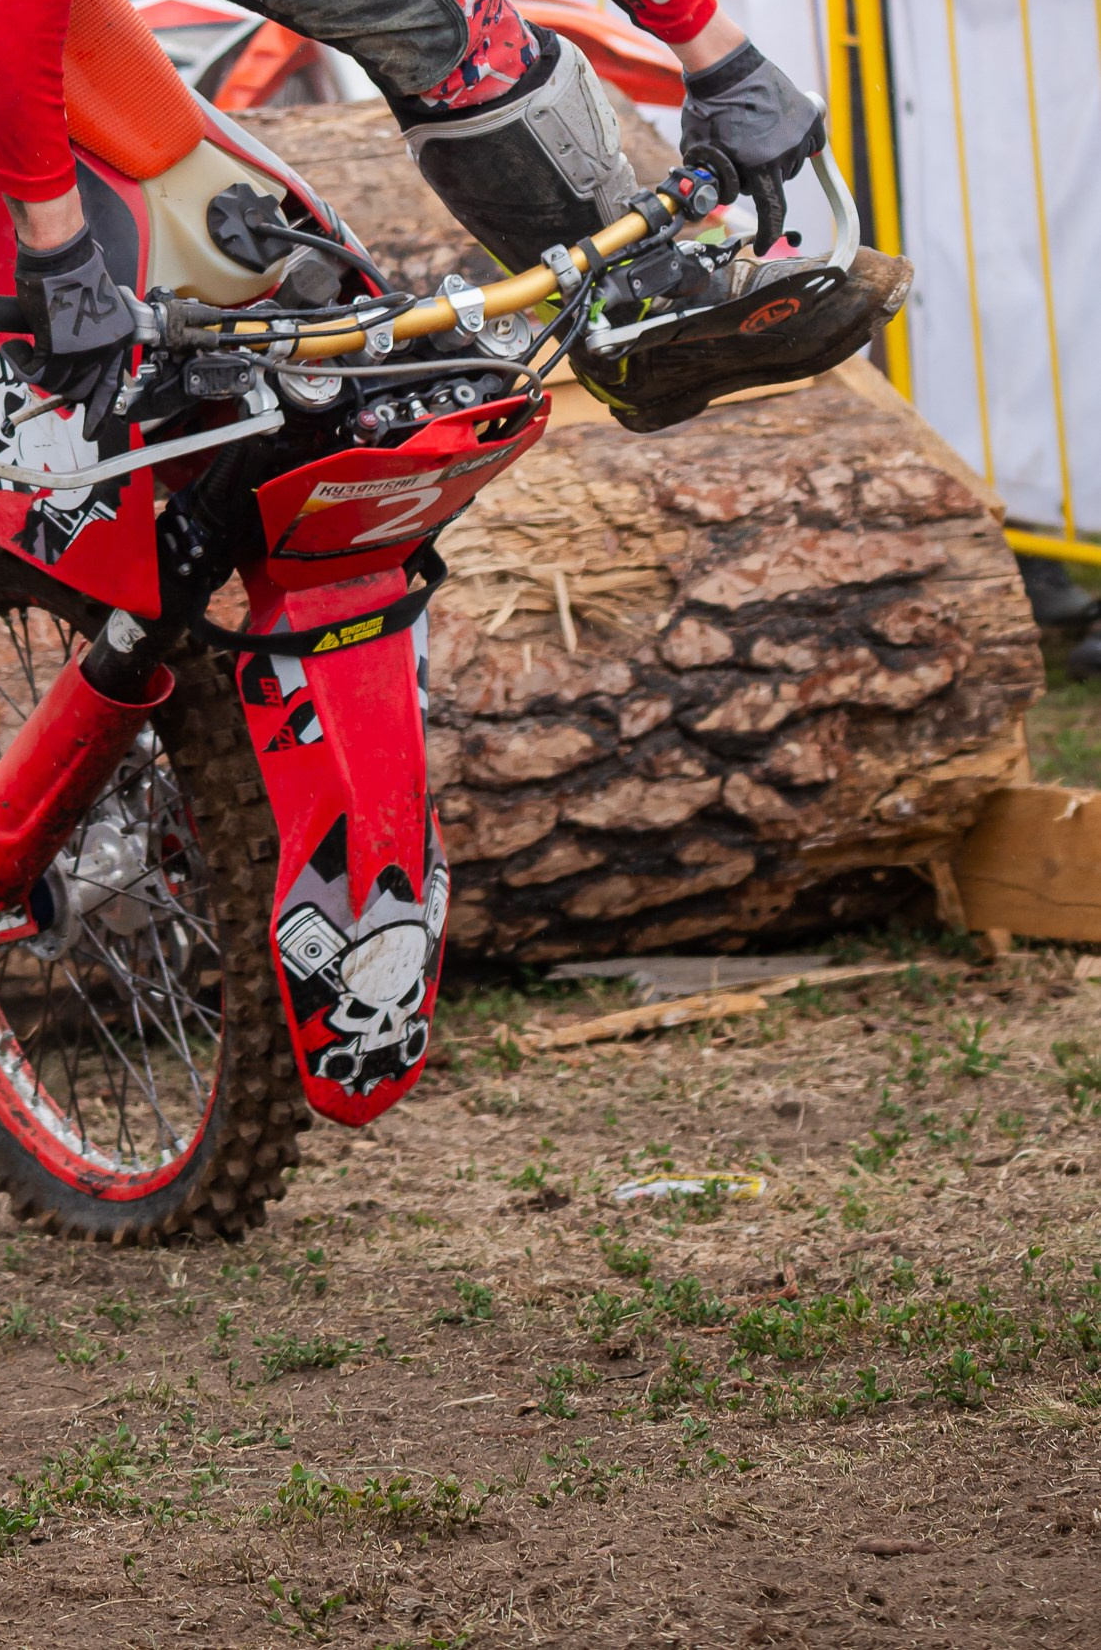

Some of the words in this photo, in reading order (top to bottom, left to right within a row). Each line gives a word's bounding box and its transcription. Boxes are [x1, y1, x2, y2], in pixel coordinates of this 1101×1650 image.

[350, 487, 443, 545] 2
[339, 614, 385, 638] ENDURO
[342, 627, 383, 645] ELEMENT
